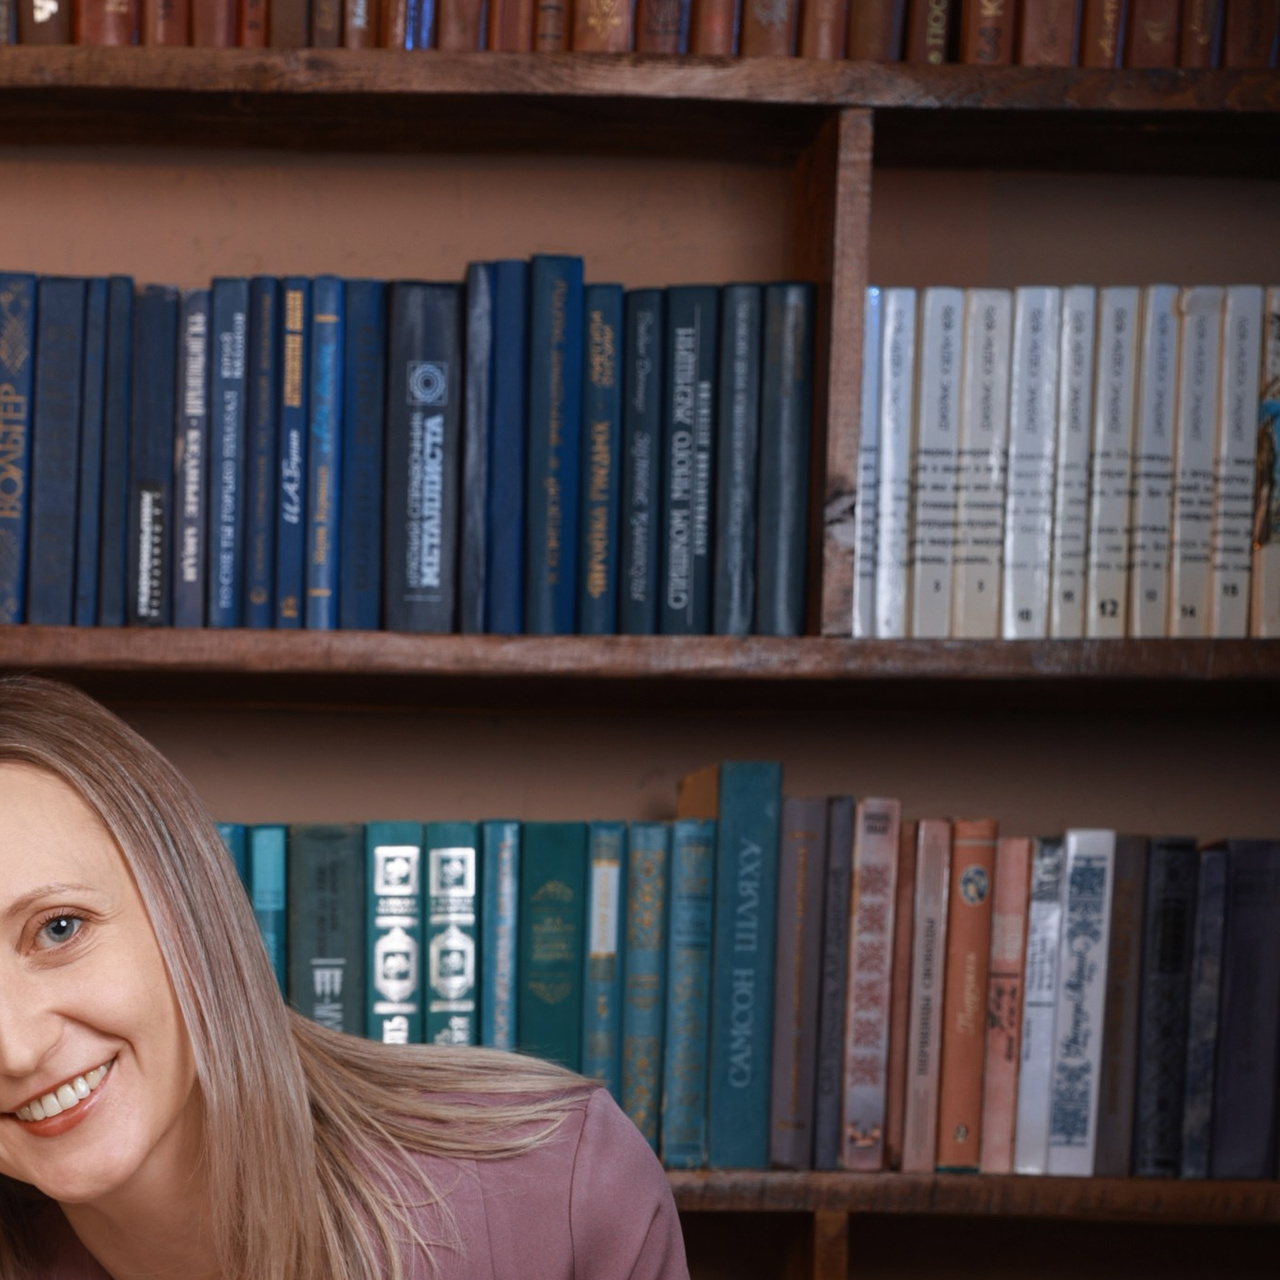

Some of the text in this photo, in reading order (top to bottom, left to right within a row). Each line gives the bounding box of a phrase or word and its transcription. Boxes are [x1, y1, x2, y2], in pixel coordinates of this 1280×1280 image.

[422, 415, 444, 588] МЕТАЛЛИСТА
[670, 431, 693, 501] МНОГО
[1096, 598, 1117, 619] 12
[729, 837, 763, 1090] САМСОН ШЛЯХУ
